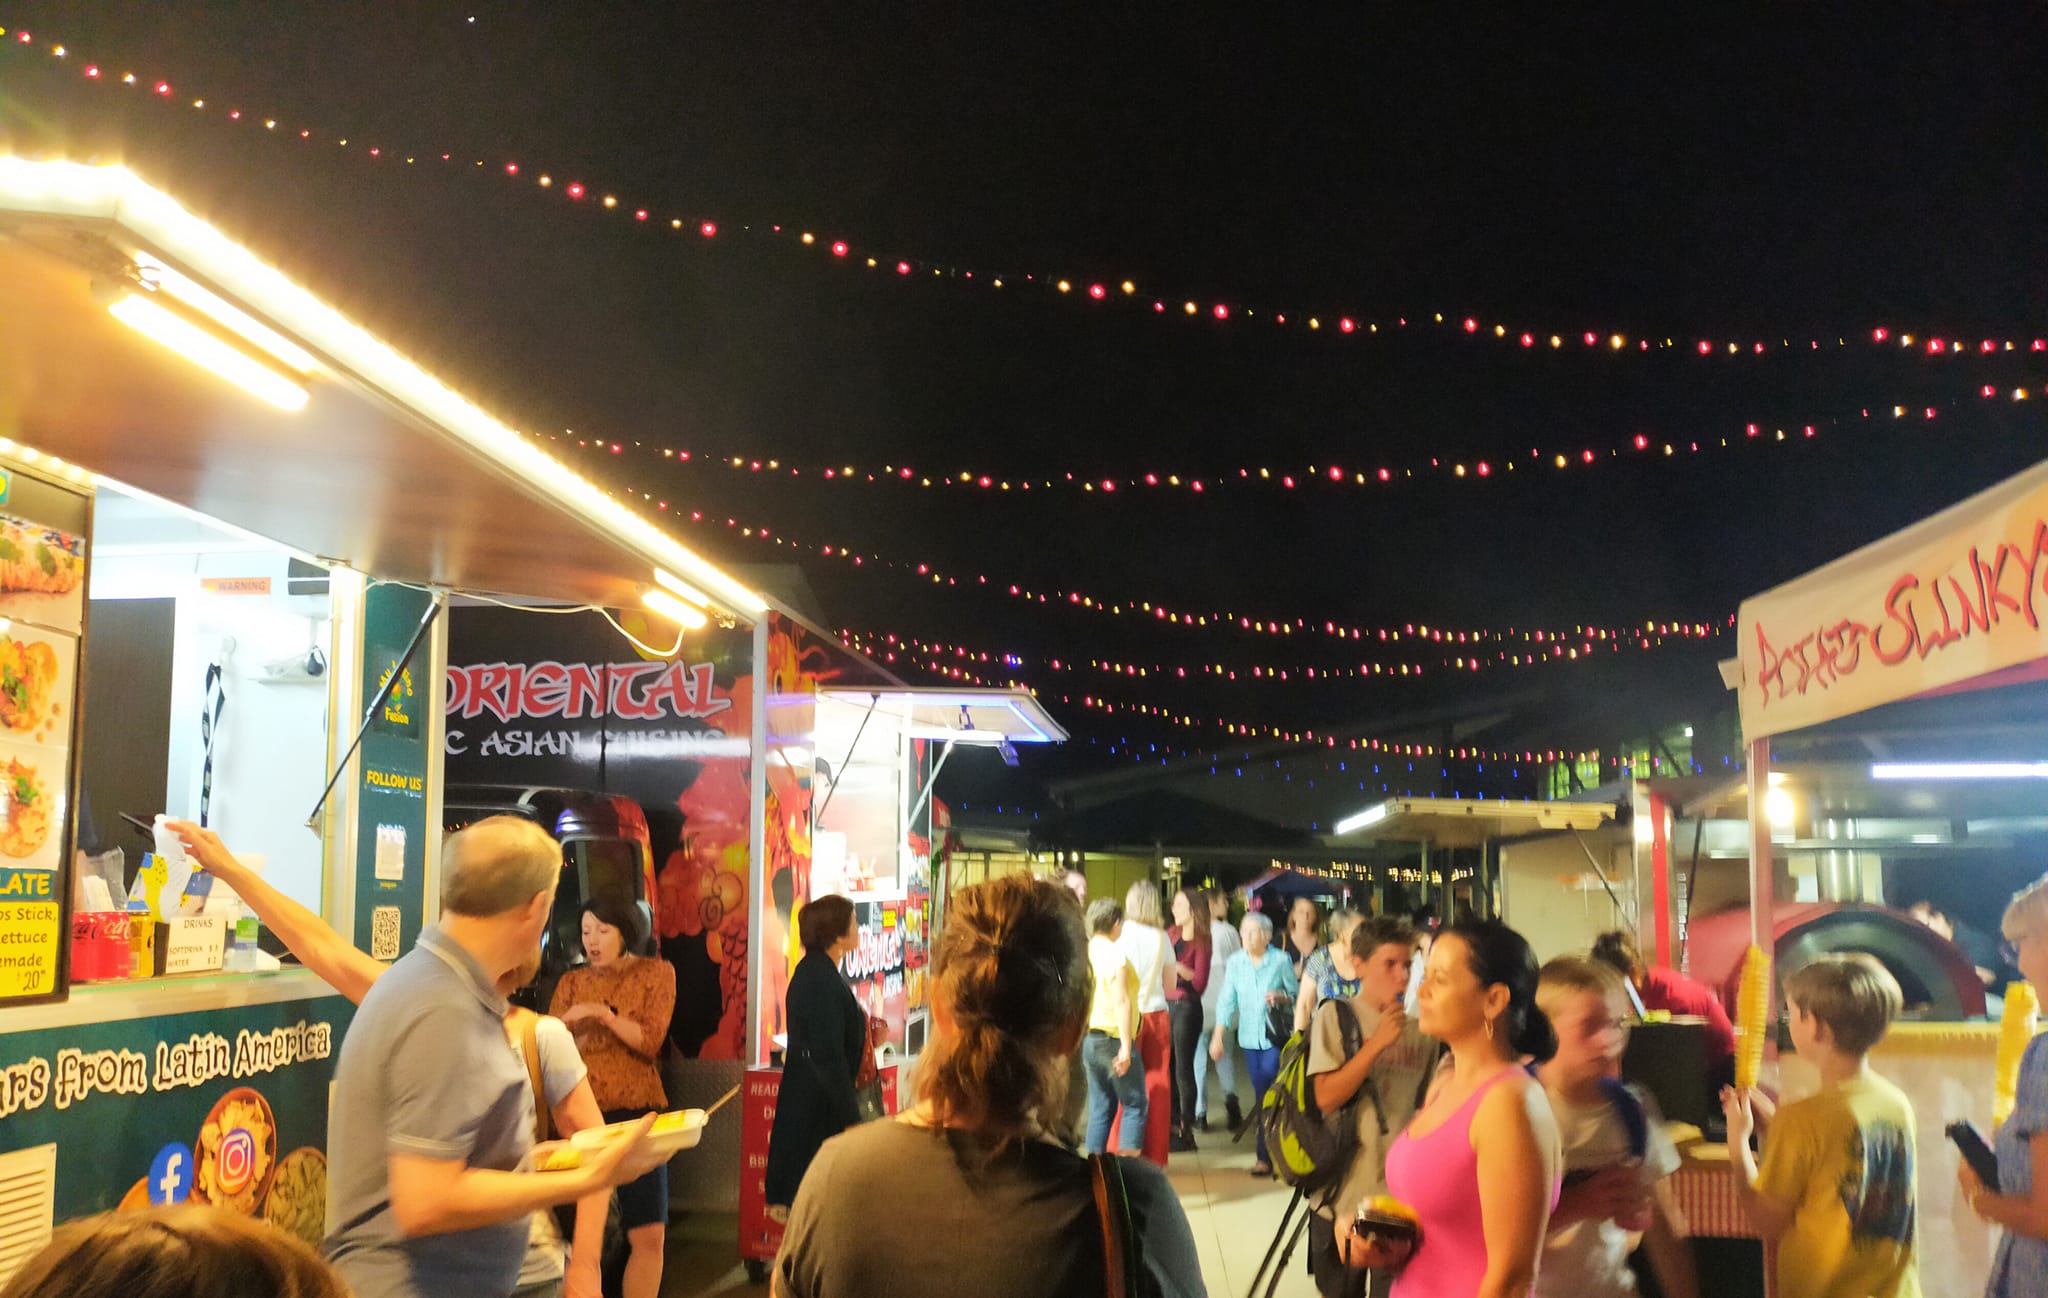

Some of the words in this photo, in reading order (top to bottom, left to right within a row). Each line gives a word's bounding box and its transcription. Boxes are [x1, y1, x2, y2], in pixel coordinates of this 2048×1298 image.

[217, 580, 267, 592] WARNING
[1869, 517, 2048, 667] SLINKY
[446, 660, 732, 723] ORIENTAL
[480, 730, 582, 757] ASIAN
[366, 770, 407, 788] FOLLOW
[409, 776, 423, 791] US
[17, 906, 57, 922] Stick,
[183, 918, 214, 930] DRINKS
[0, 1059, 49, 1115] rs
[56, 1050, 146, 1107] from
[154, 1034, 229, 1089] Latin
[235, 1022, 330, 1076] America
[750, 1083, 780, 1097] READ
